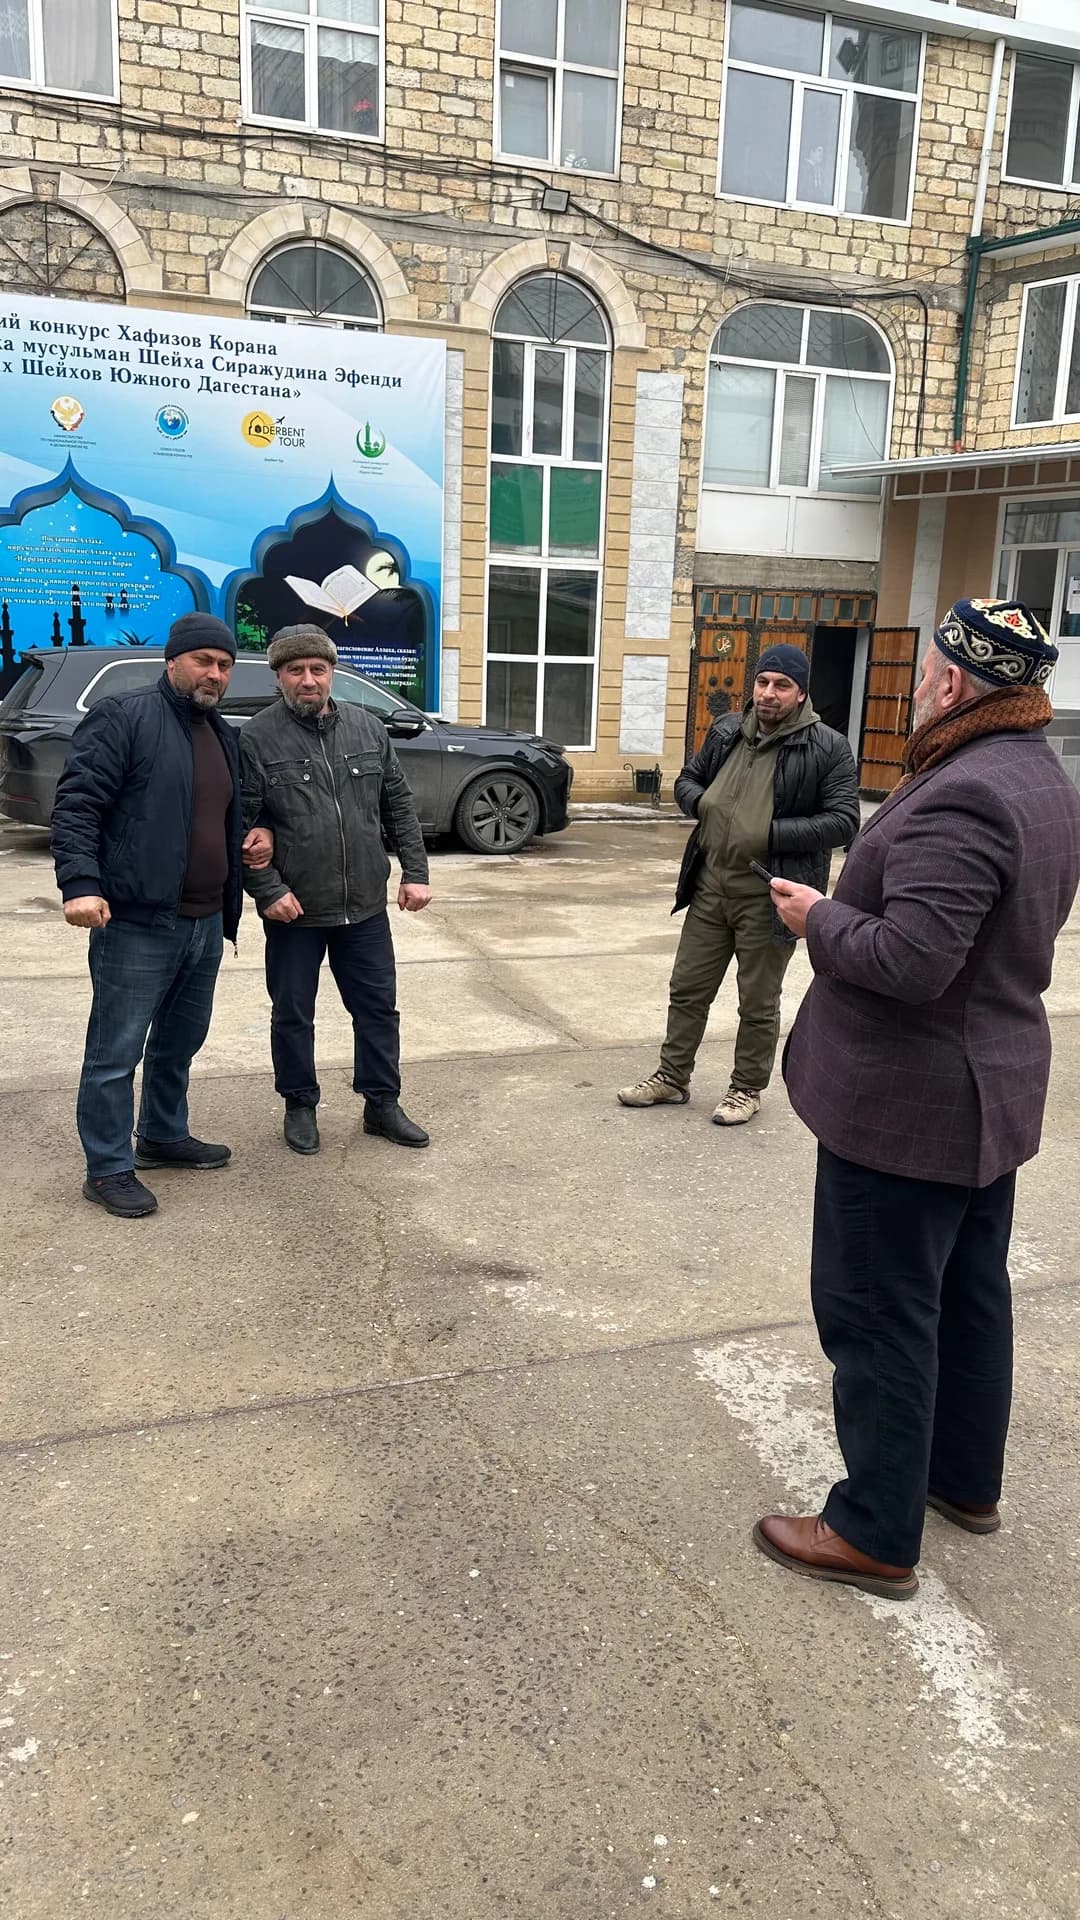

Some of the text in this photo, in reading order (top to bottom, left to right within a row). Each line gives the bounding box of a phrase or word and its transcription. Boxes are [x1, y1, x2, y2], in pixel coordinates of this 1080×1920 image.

[29, 319, 111, 342] конкурс
[117, 324, 202, 348] Хафизов
[209, 334, 278, 356] Корана
[22, 358, 102, 381] Шейхов
[110, 366, 191, 390] Южного
[197, 375, 302, 399] Дагестана»
[23, 341, 130, 362] мусульман
[138, 348, 204, 370] Шейха
[212, 355, 328, 381] Сиражудина
[334, 367, 403, 389] Эфенди
[279, 436, 306, 448] TOUR
